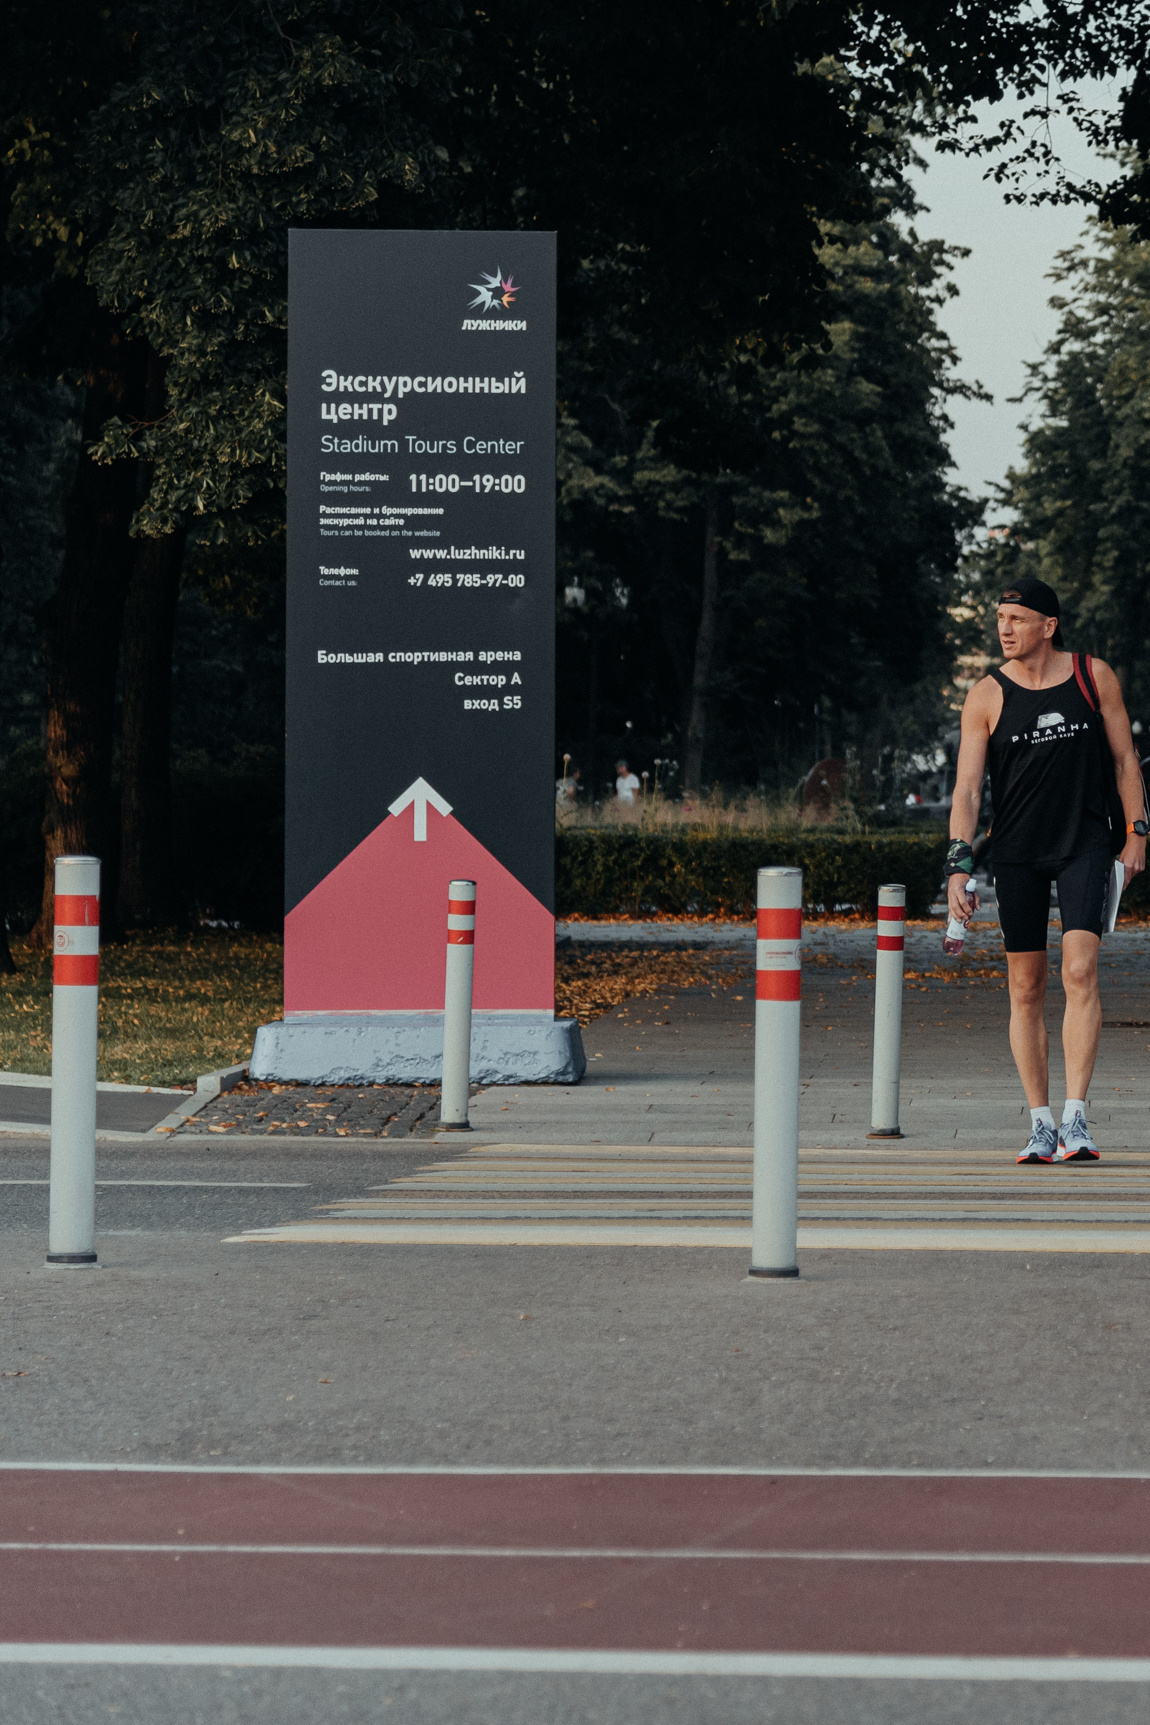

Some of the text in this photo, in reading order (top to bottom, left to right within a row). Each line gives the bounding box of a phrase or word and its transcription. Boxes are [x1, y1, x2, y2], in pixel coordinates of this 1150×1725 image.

[320, 369, 527, 399] Экскурсионный
[321, 402, 398, 426] центр
[320, 434, 525, 455] Stadium Tours Center
[319, 471, 390, 483] График работы:
[319, 483, 349, 494] Opening
[319, 504, 445, 517] Расписание и бронирование
[319, 516, 405, 527] экскурсий на сайте
[319, 528, 339, 537] Tours
[340, 529, 353, 537] can
[353, 528, 364, 537] be
[364, 528, 390, 537] booked
[401, 529, 413, 537] the
[413, 529, 441, 537] website
[408, 545, 525, 560] www.luzhniki.ru
[318, 565, 360, 577] Телефон:
[318, 578, 346, 587] Contact
[407, 573, 525, 588] +7 495 785-97-00
[317, 649, 522, 666] Большая спортивная арена
[454, 672, 507, 689] Сектор
[463, 695, 522, 712] вход S5
[1012, 723, 1089, 742] PIRANHA
